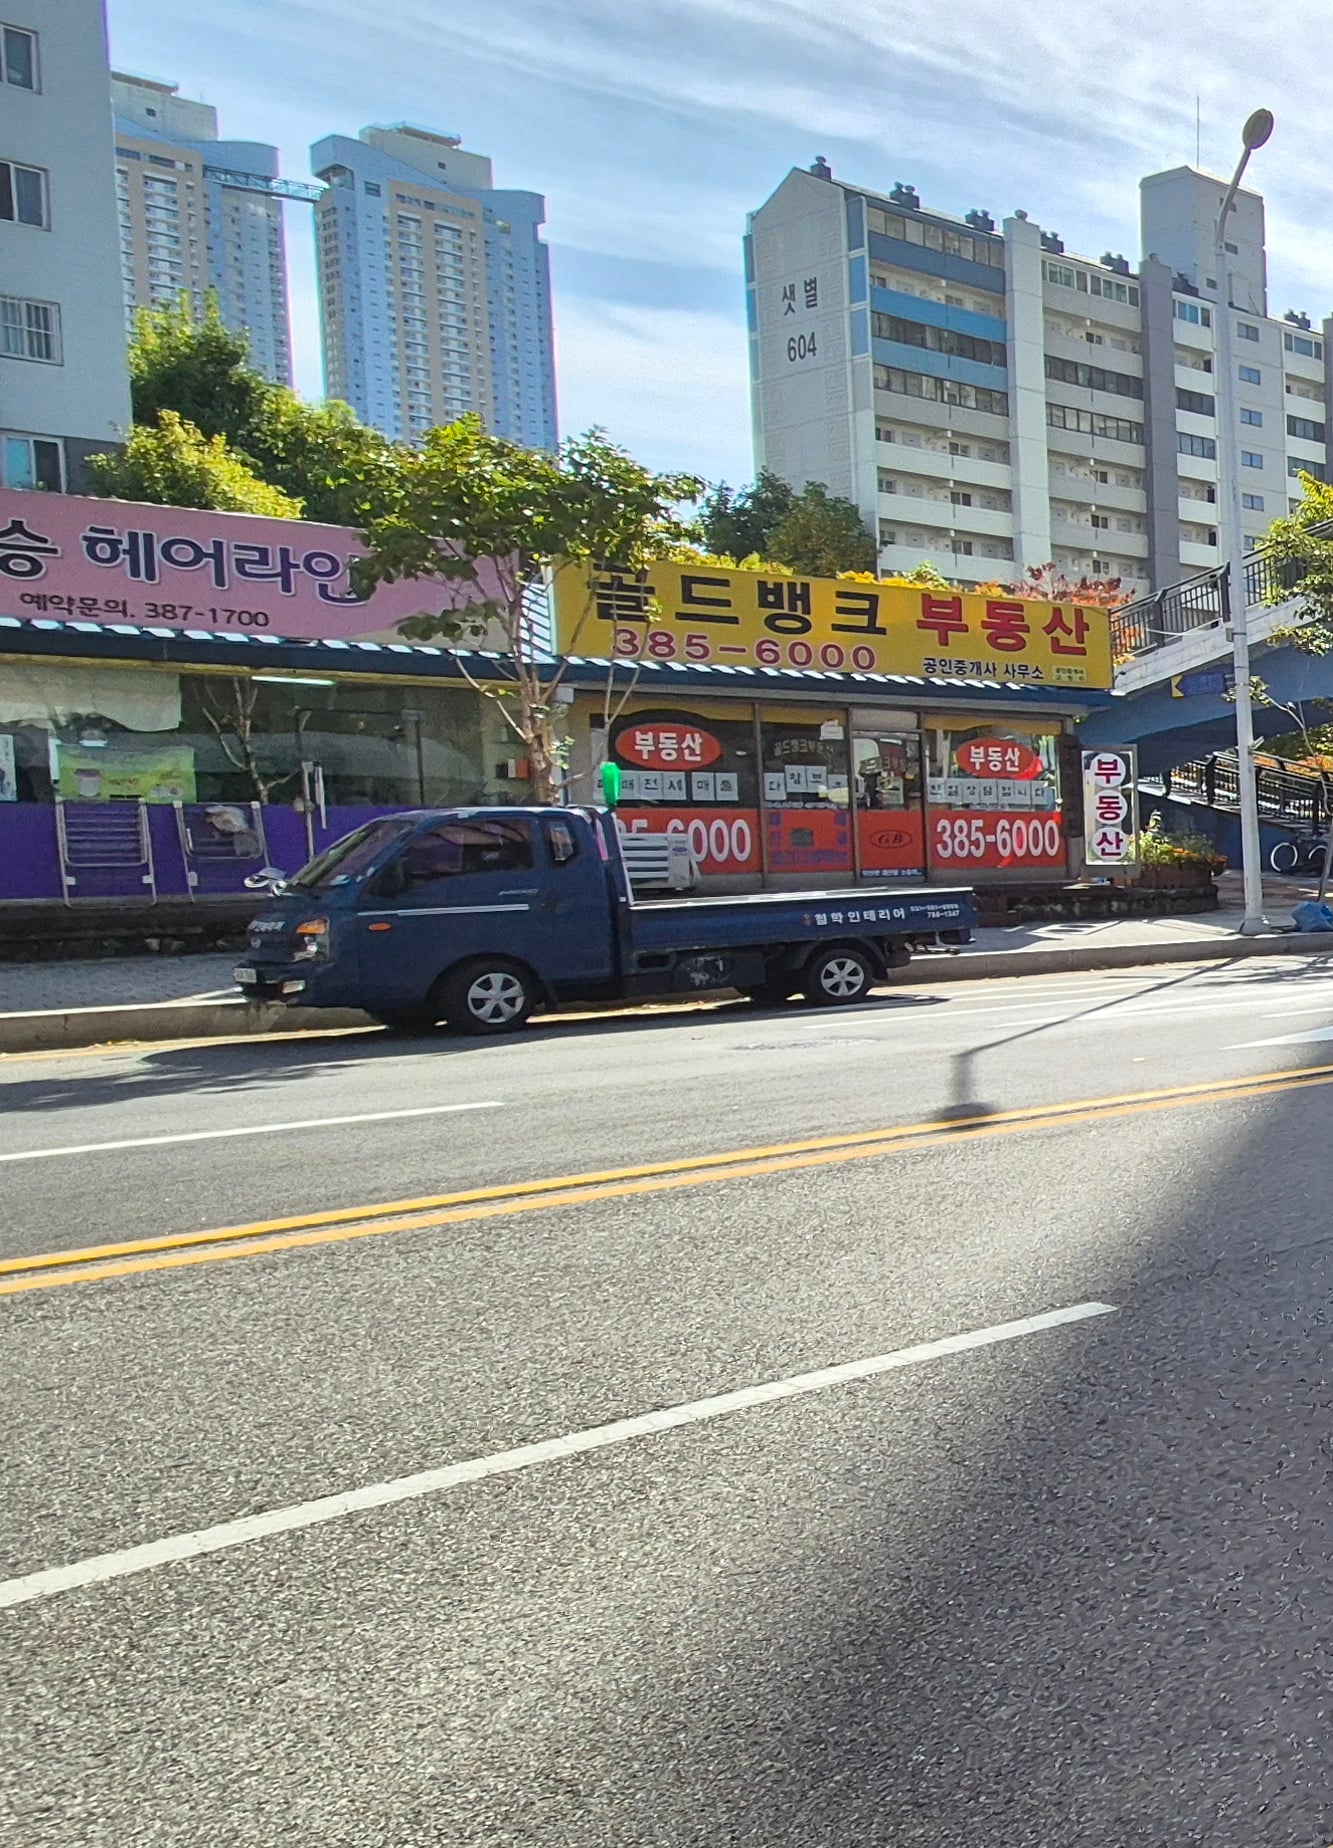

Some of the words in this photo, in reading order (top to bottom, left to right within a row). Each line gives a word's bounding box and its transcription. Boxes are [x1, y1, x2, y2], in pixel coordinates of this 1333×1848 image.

[782, 277, 818, 316] 샛별
[787, 331, 818, 362] 604
[81, 526, 370, 605] 헤어라인
[145, 602, 270, 628] 387-1700
[587, 562, 888, 636] 골드뱅크
[915, 592, 1090, 656] 부동산
[613, 628, 877, 671] 385-6000
[923, 657, 997, 678] 공인중개사
[1003, 663, 1045, 680] 사무소
[634, 730, 703, 762] 부동산
[969, 745, 1020, 772] 부동산
[1094, 758, 1124, 857] 부동산
[936, 818, 1060, 859] 385-6000
